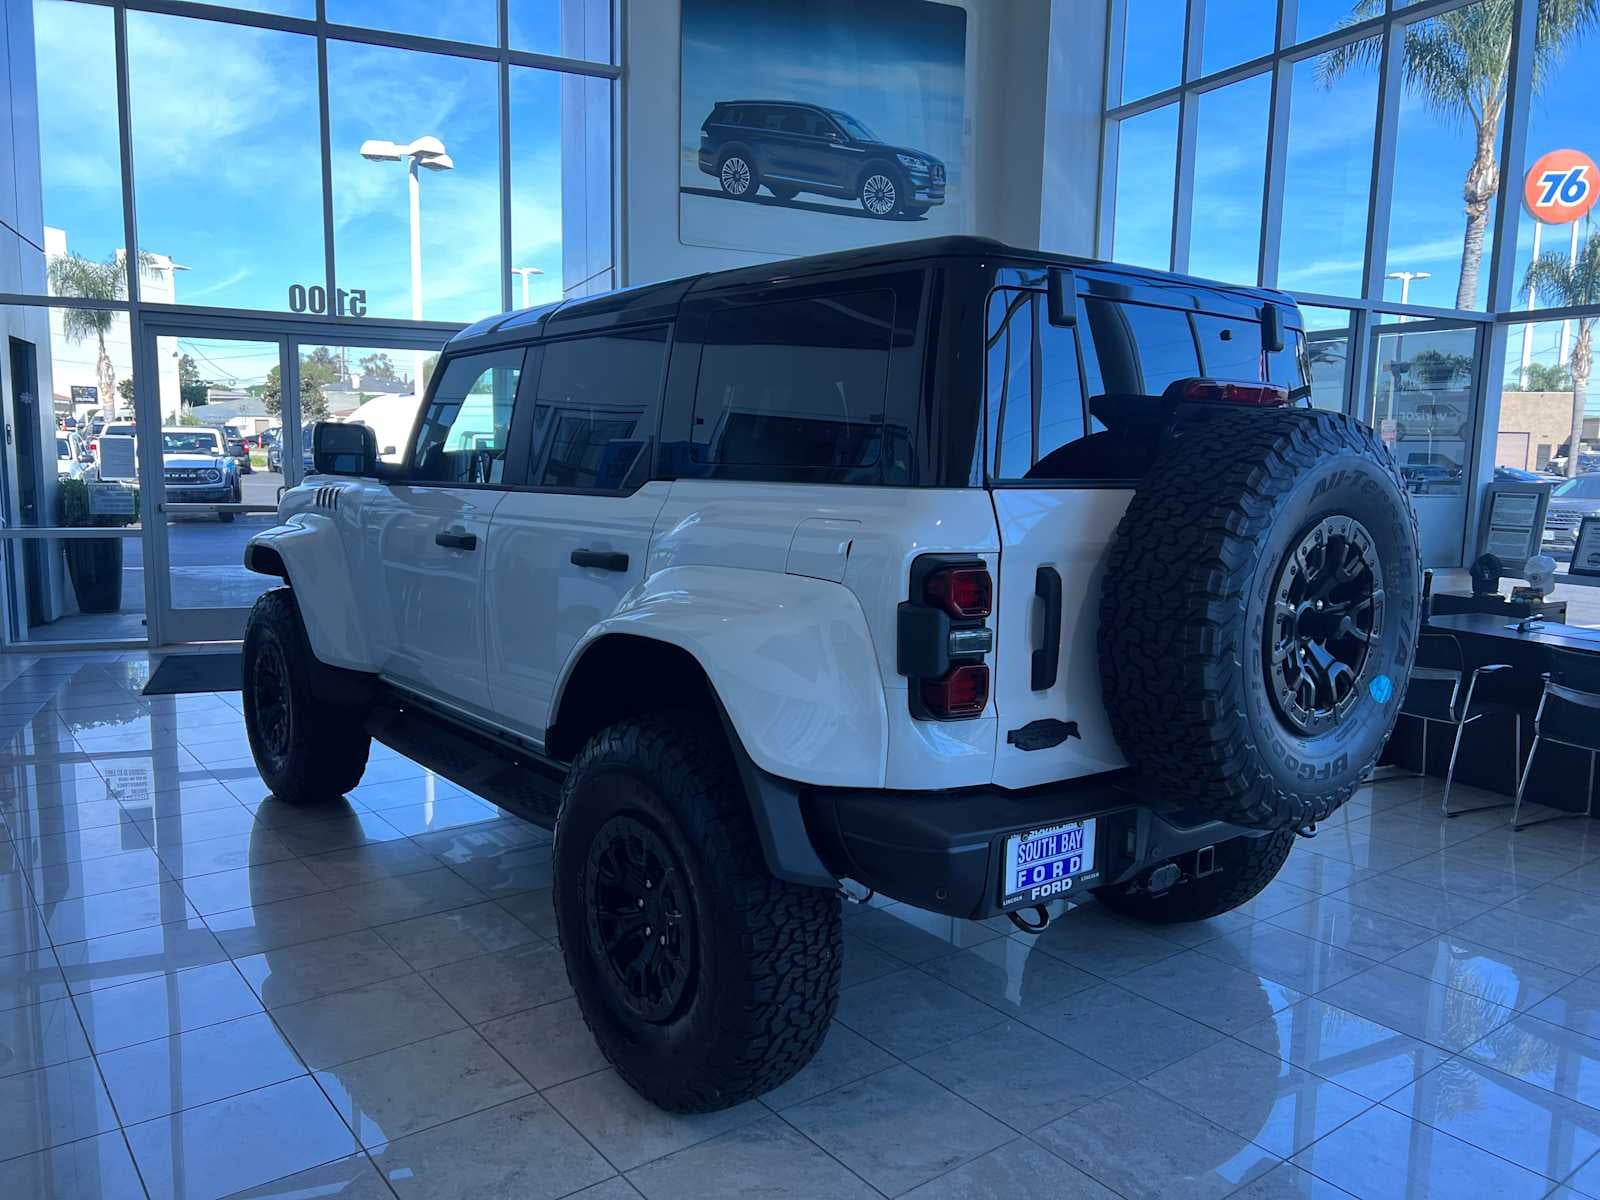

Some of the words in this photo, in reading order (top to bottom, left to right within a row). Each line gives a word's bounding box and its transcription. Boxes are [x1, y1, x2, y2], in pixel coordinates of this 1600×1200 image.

[1536, 165, 1591, 207] 76
[1018, 837, 1057, 863] SOUTH
[1061, 830, 1083, 852] BAY
[1018, 856, 1081, 888] FORD
[1031, 878, 1072, 901] FORD
